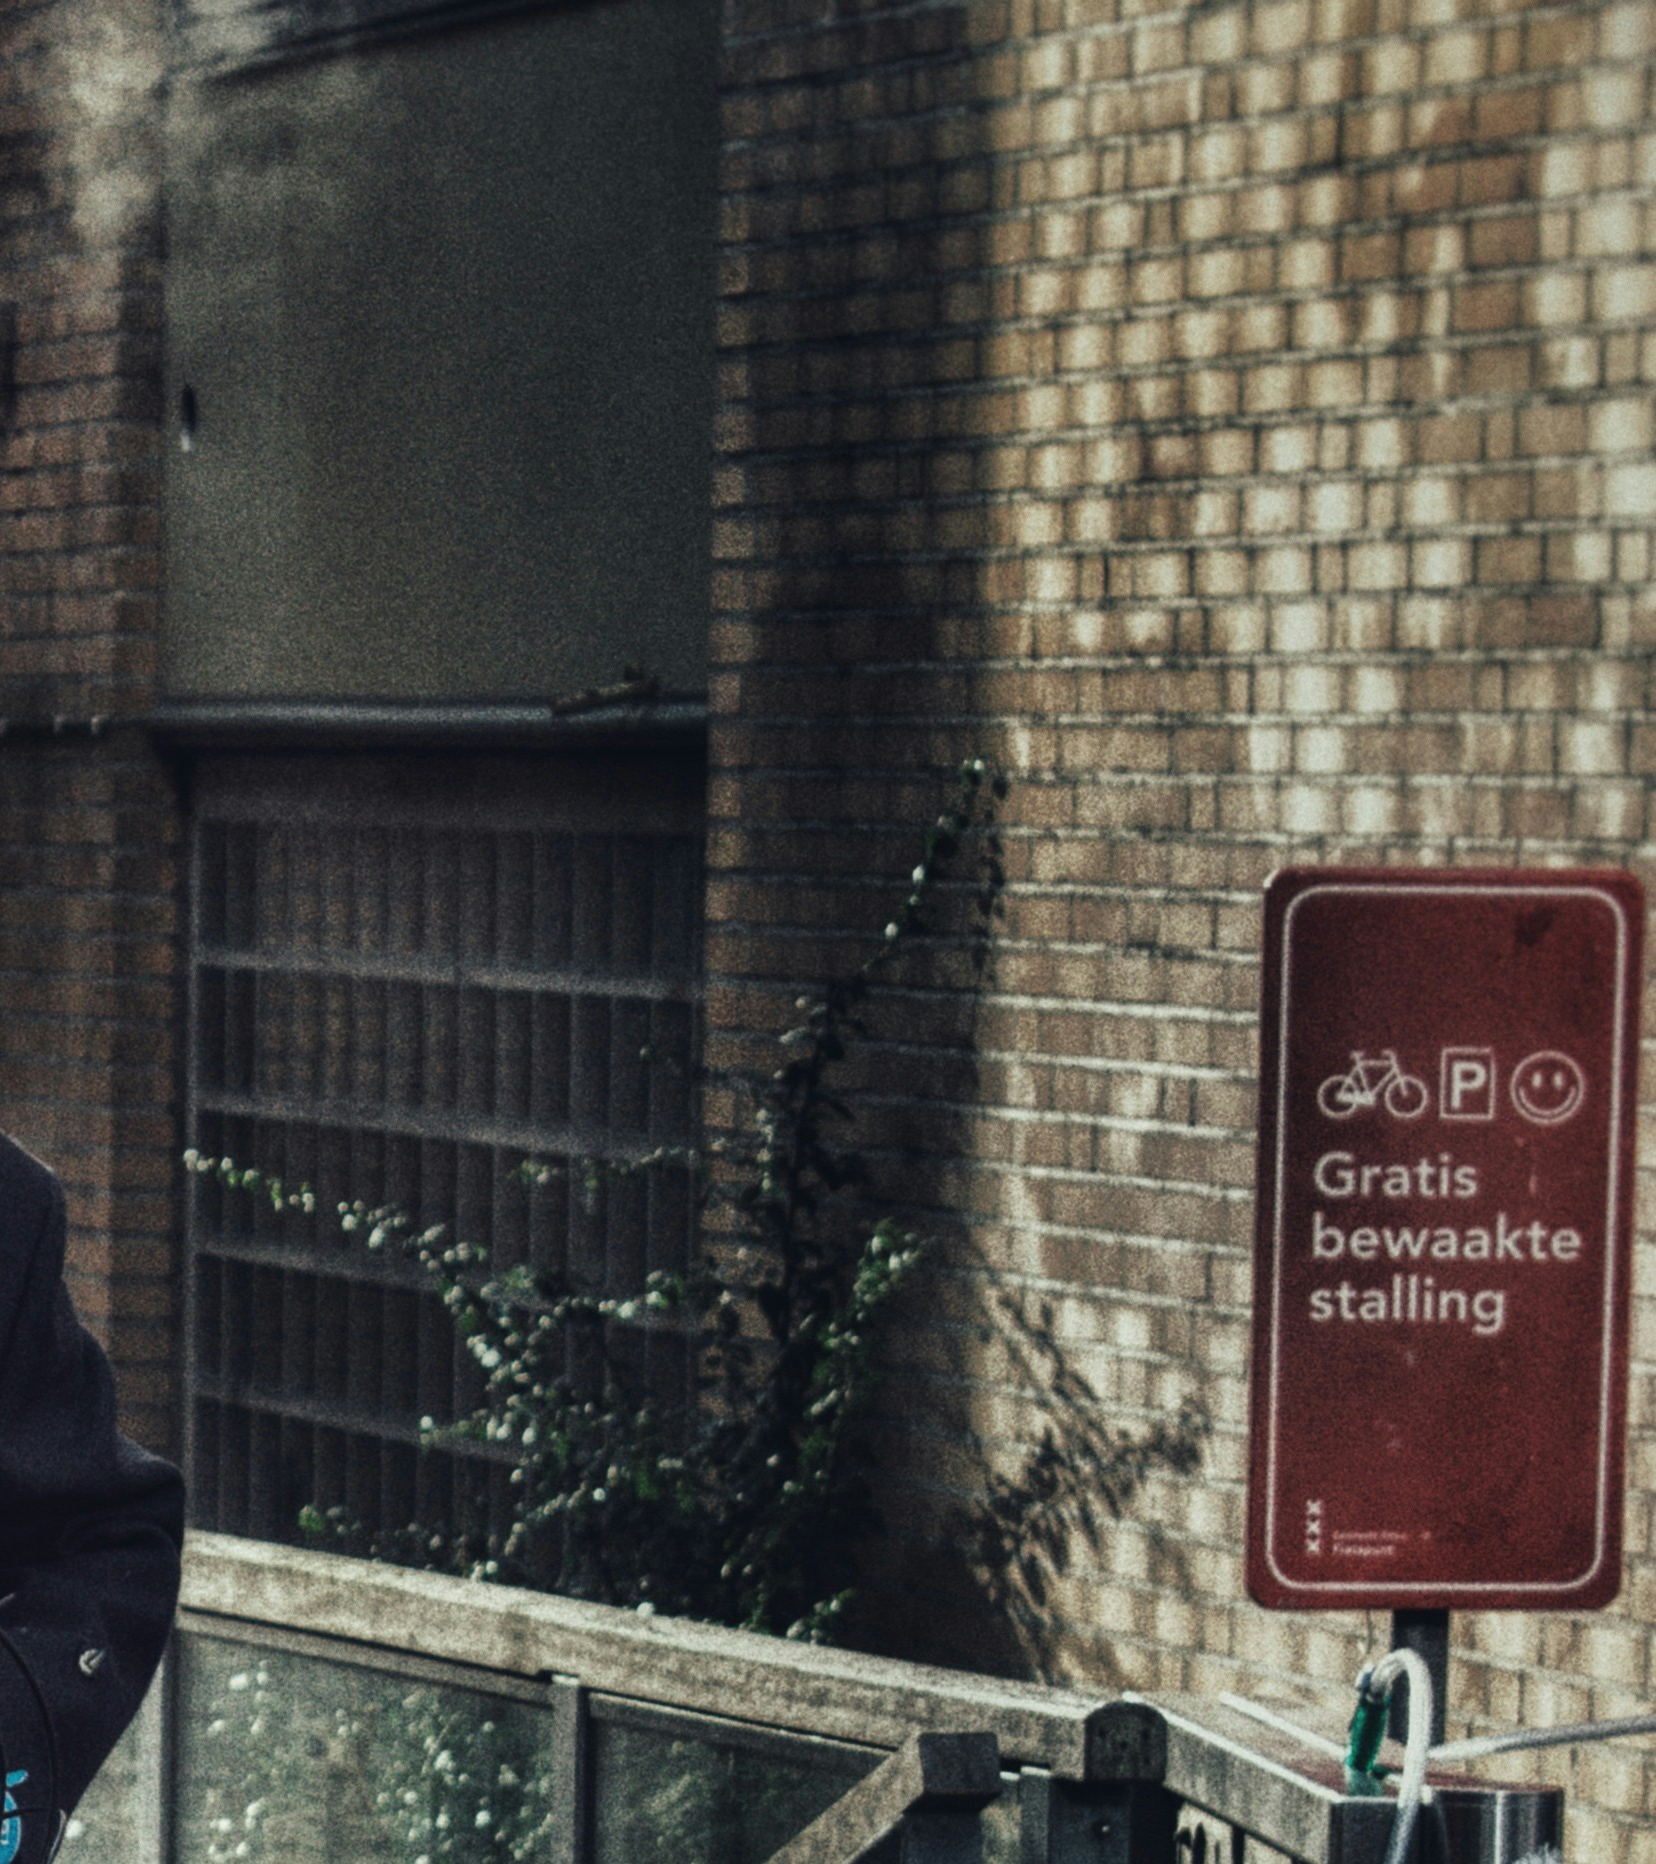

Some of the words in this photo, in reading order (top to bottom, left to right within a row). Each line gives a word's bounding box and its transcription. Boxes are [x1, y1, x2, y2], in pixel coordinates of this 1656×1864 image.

[1312, 1150, 1478, 1198] Gratis
[1311, 1210, 1582, 1260] bewaakte
[1308, 1273, 1506, 1336] stalling
